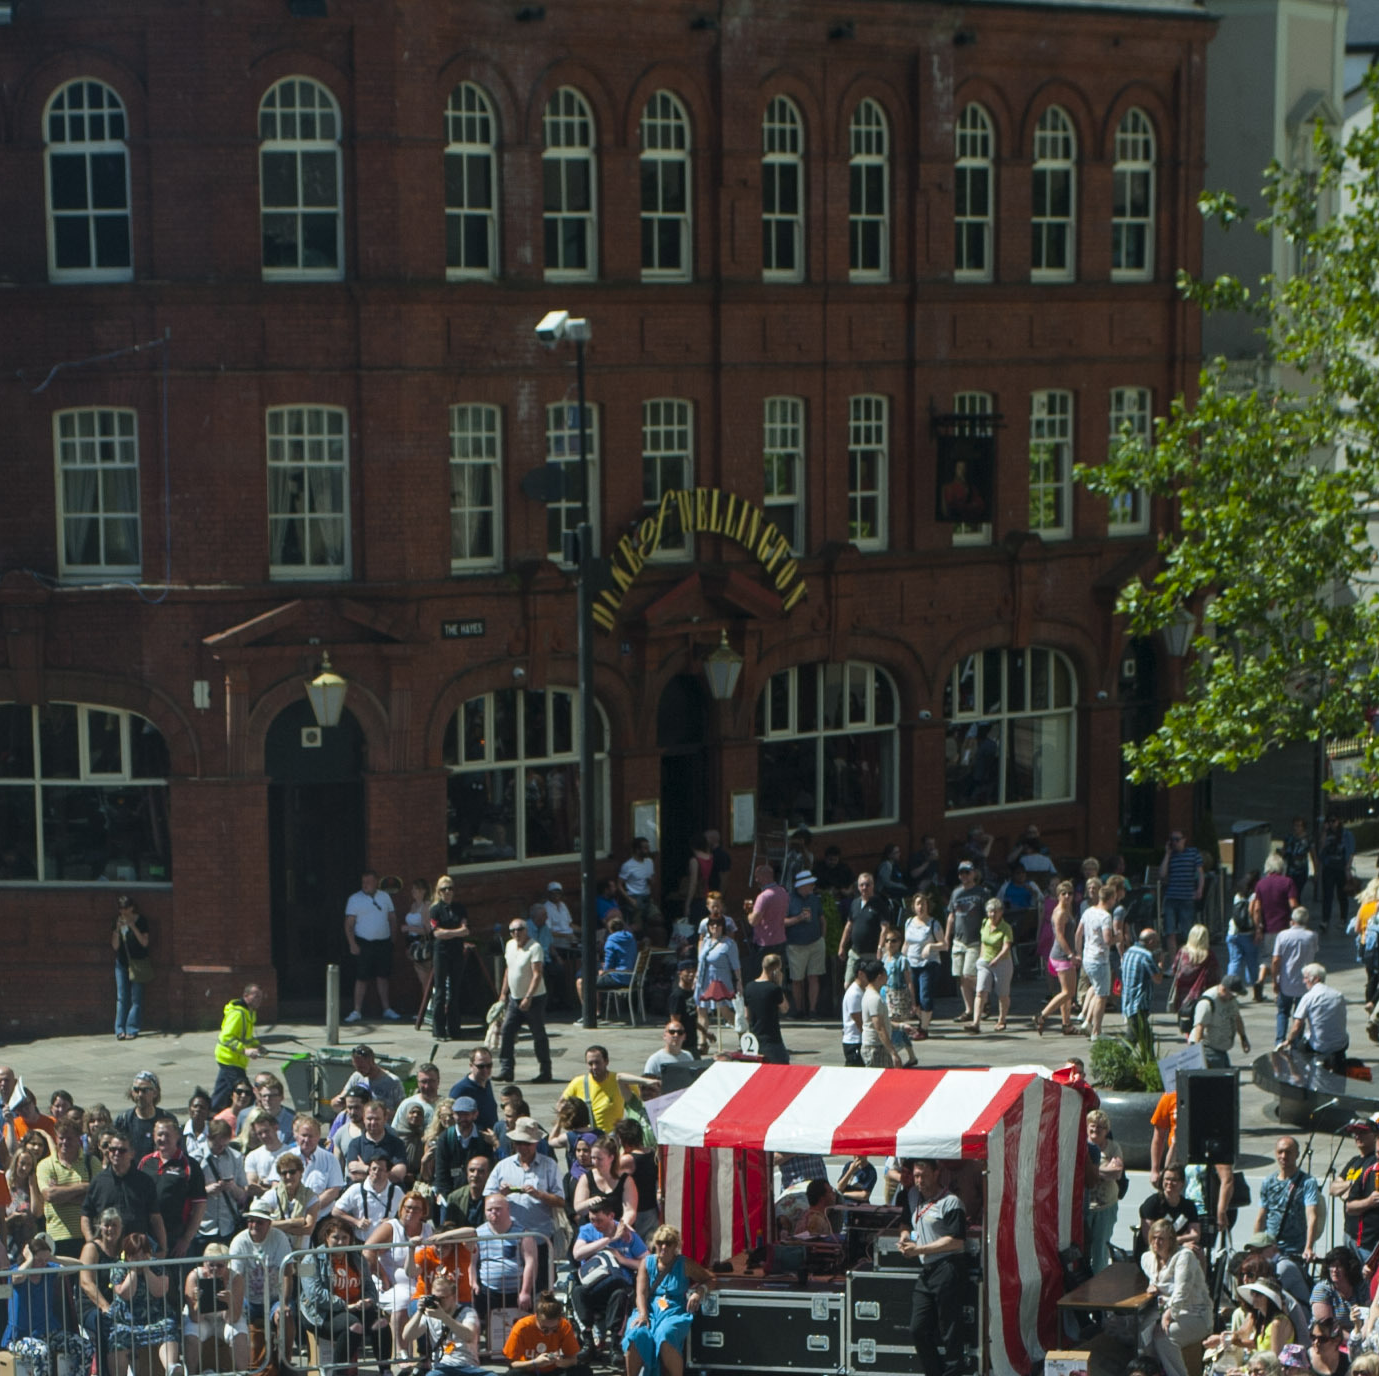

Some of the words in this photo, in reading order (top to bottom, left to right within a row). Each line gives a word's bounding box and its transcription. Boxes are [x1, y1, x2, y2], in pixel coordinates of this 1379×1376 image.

[638, 488, 675, 559] of
[677, 487, 809, 612] WELLINGTON
[444, 623, 458, 636] THE
[461, 622, 483, 635] HAYES
